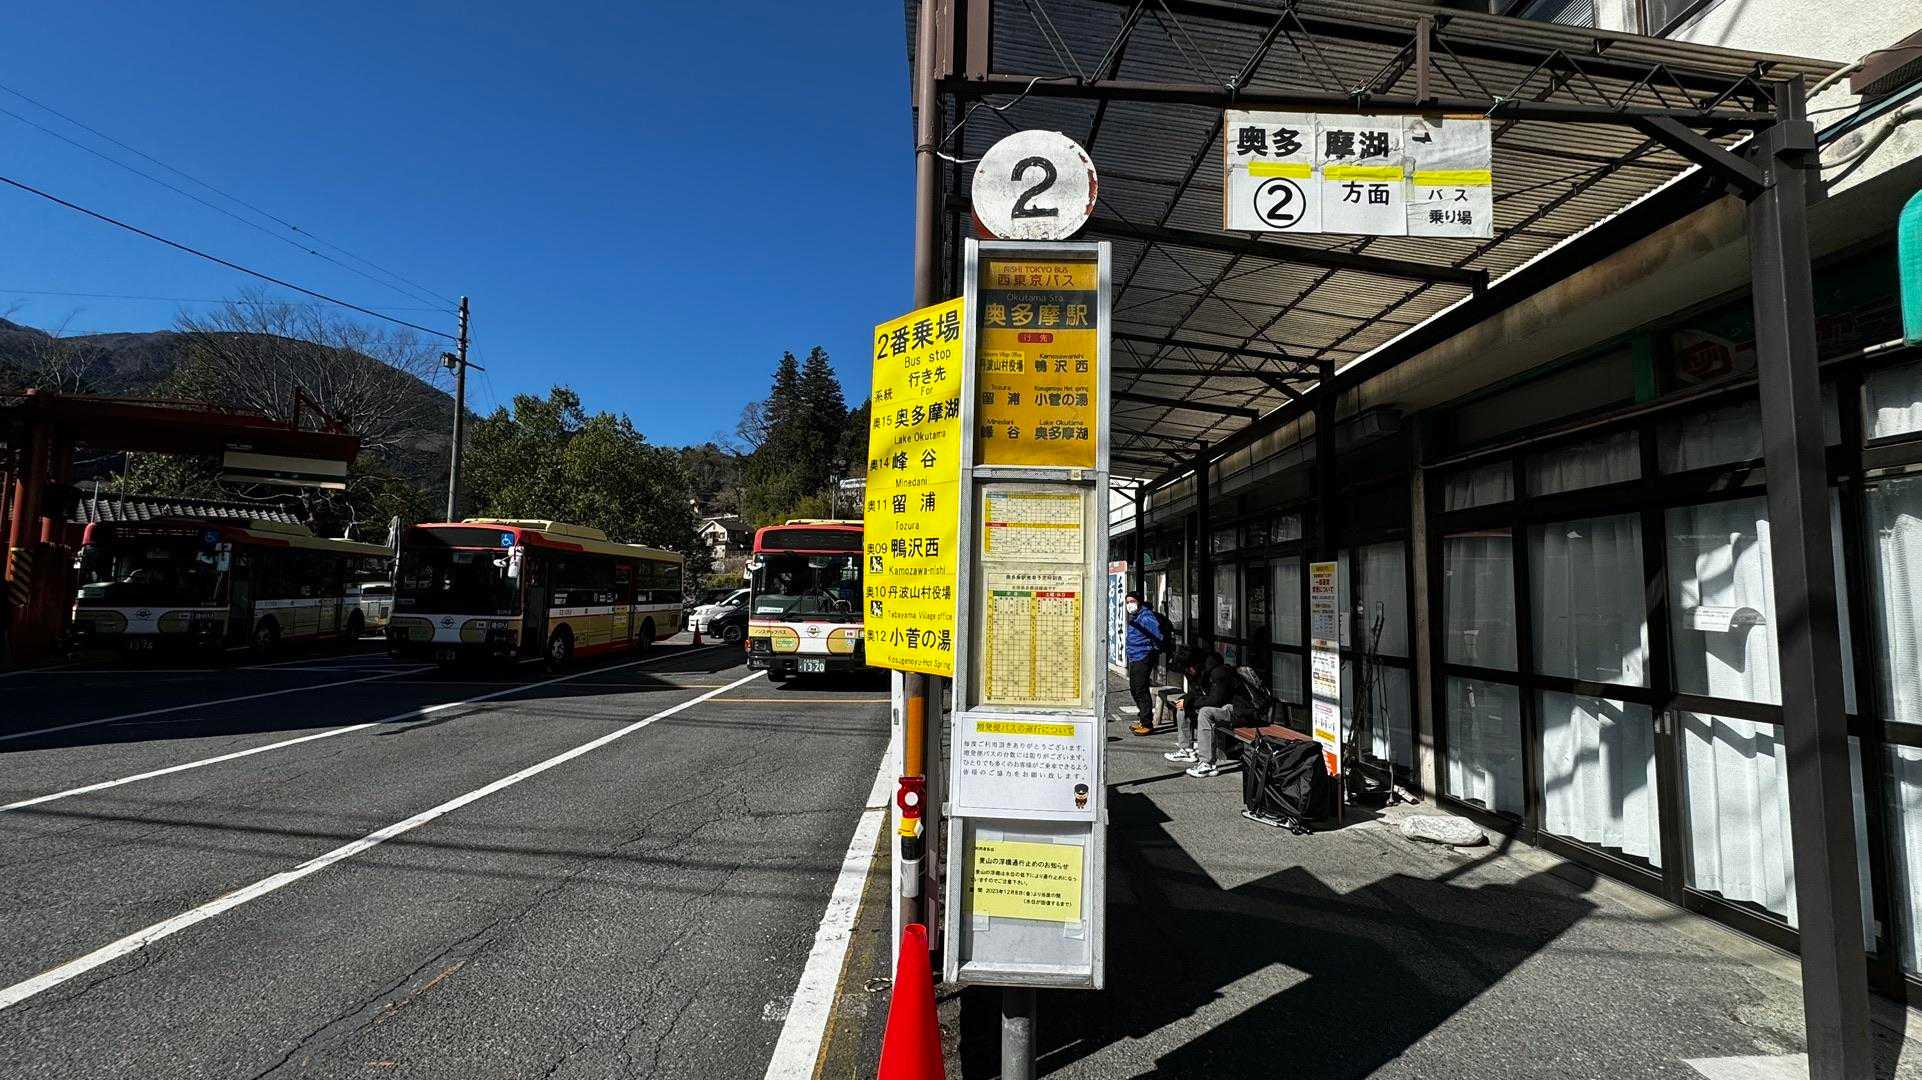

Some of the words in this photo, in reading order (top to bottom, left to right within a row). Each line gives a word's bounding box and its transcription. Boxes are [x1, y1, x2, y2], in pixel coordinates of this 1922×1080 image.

[1011, 156, 1059, 219] 2
[1342, 181, 1390, 205] 方面
[1429, 210, 1472, 225] 乗り場
[997, 274, 1074, 287] 西東京バス
[984, 303, 1088, 326] 奥多摩駅
[877, 309, 960, 360] 2番乗場
[905, 356, 920, 368] Bus
[929, 349, 951, 362] stop
[1034, 359, 1088, 373] 鴨沢西
[909, 366, 946, 388] 行き先
[875, 388, 893, 402] 系統
[921, 386, 933, 396] For
[1034, 393, 1088, 406] 小菅の湯
[873, 415, 892, 429] 奥15
[895, 398, 959, 428] 奥多摩湖
[895, 434, 912, 445] Lake
[914, 430, 946, 442] Okutama
[1034, 427, 1088, 440] 奥多摩湖
[870, 457, 889, 471] 奥14
[892, 448, 936, 470] 峰谷
[896, 479, 928, 488] Minedani
[867, 499, 887, 512] 奥11
[893, 491, 936, 514] 留浦
[896, 521, 919, 530] Tozura
[867, 543, 887, 555] 奥09
[891, 537, 940, 558] 鴨沢西
[866, 586, 887, 599] 奥10
[888, 586, 951, 600] 丹波山村役場
[867, 630, 887, 641] 奥12
[890, 627, 951, 652] 小菅の湯
